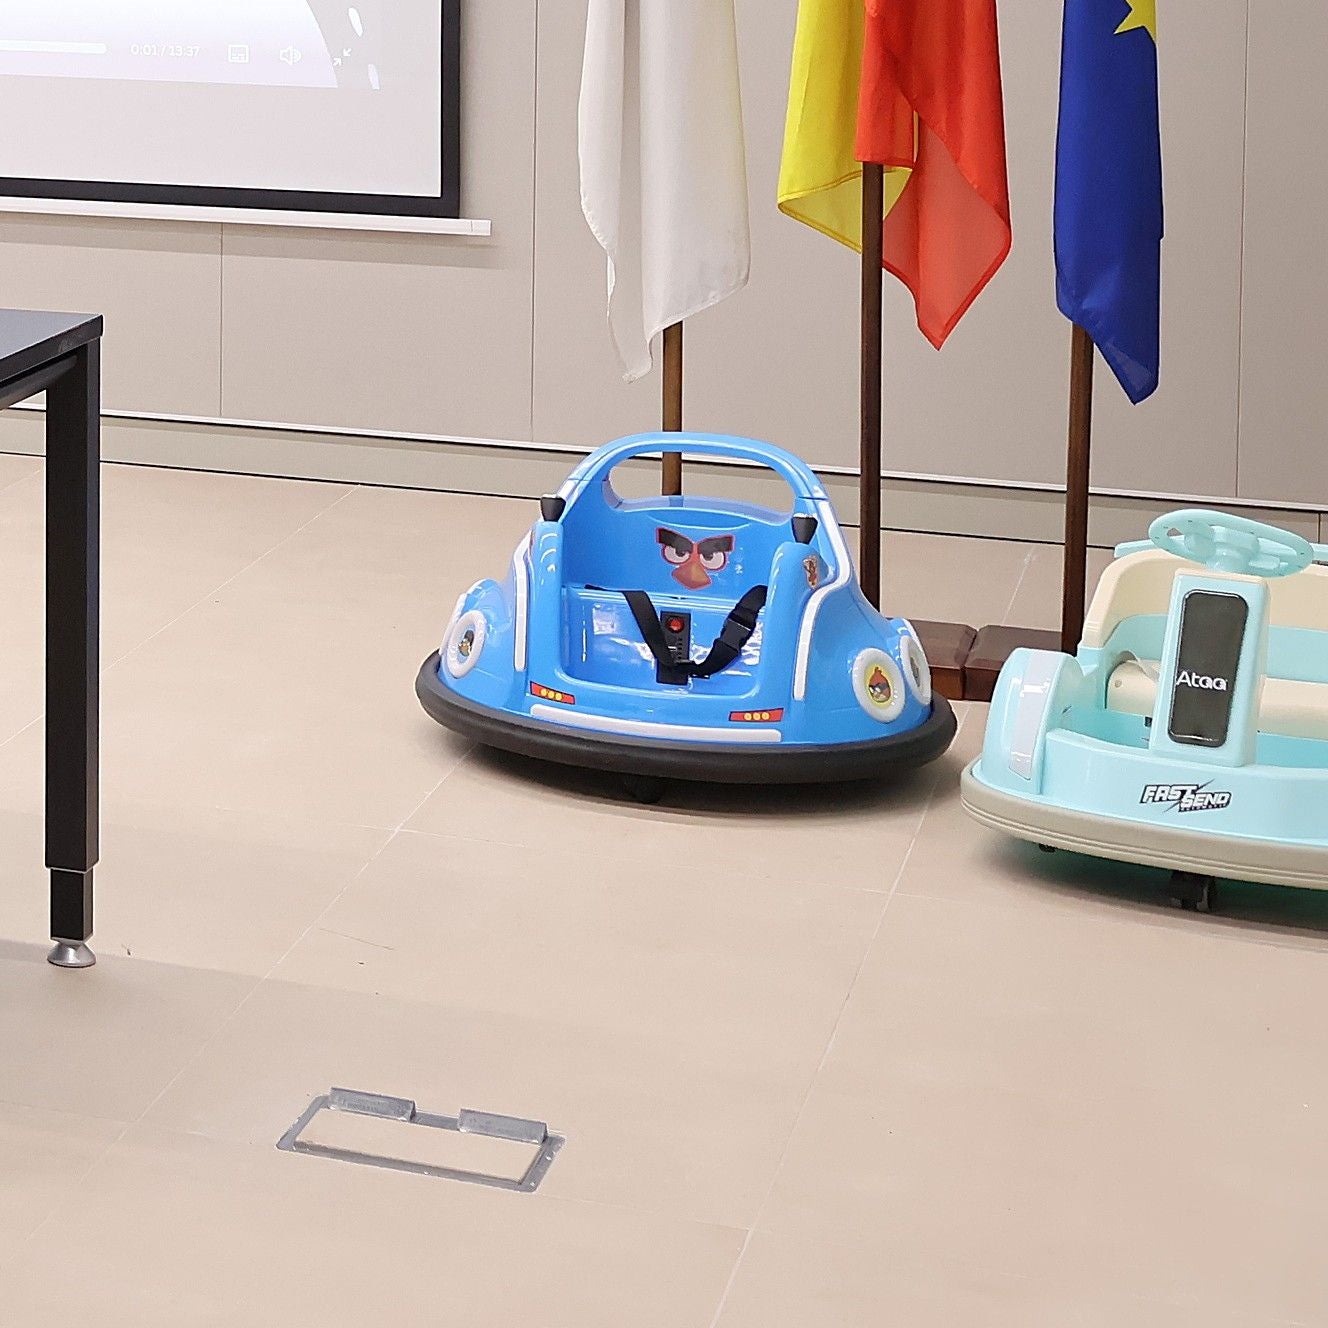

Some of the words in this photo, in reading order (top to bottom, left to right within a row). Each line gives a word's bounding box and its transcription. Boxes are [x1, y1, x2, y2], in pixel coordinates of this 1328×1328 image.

[130, 43, 157, 56] 0:01
[168, 44, 201, 57] 13:37
[1176, 671, 1228, 691] Ataa
[1141, 784, 1199, 803] FAST
[1180, 792, 1231, 808] SEND
